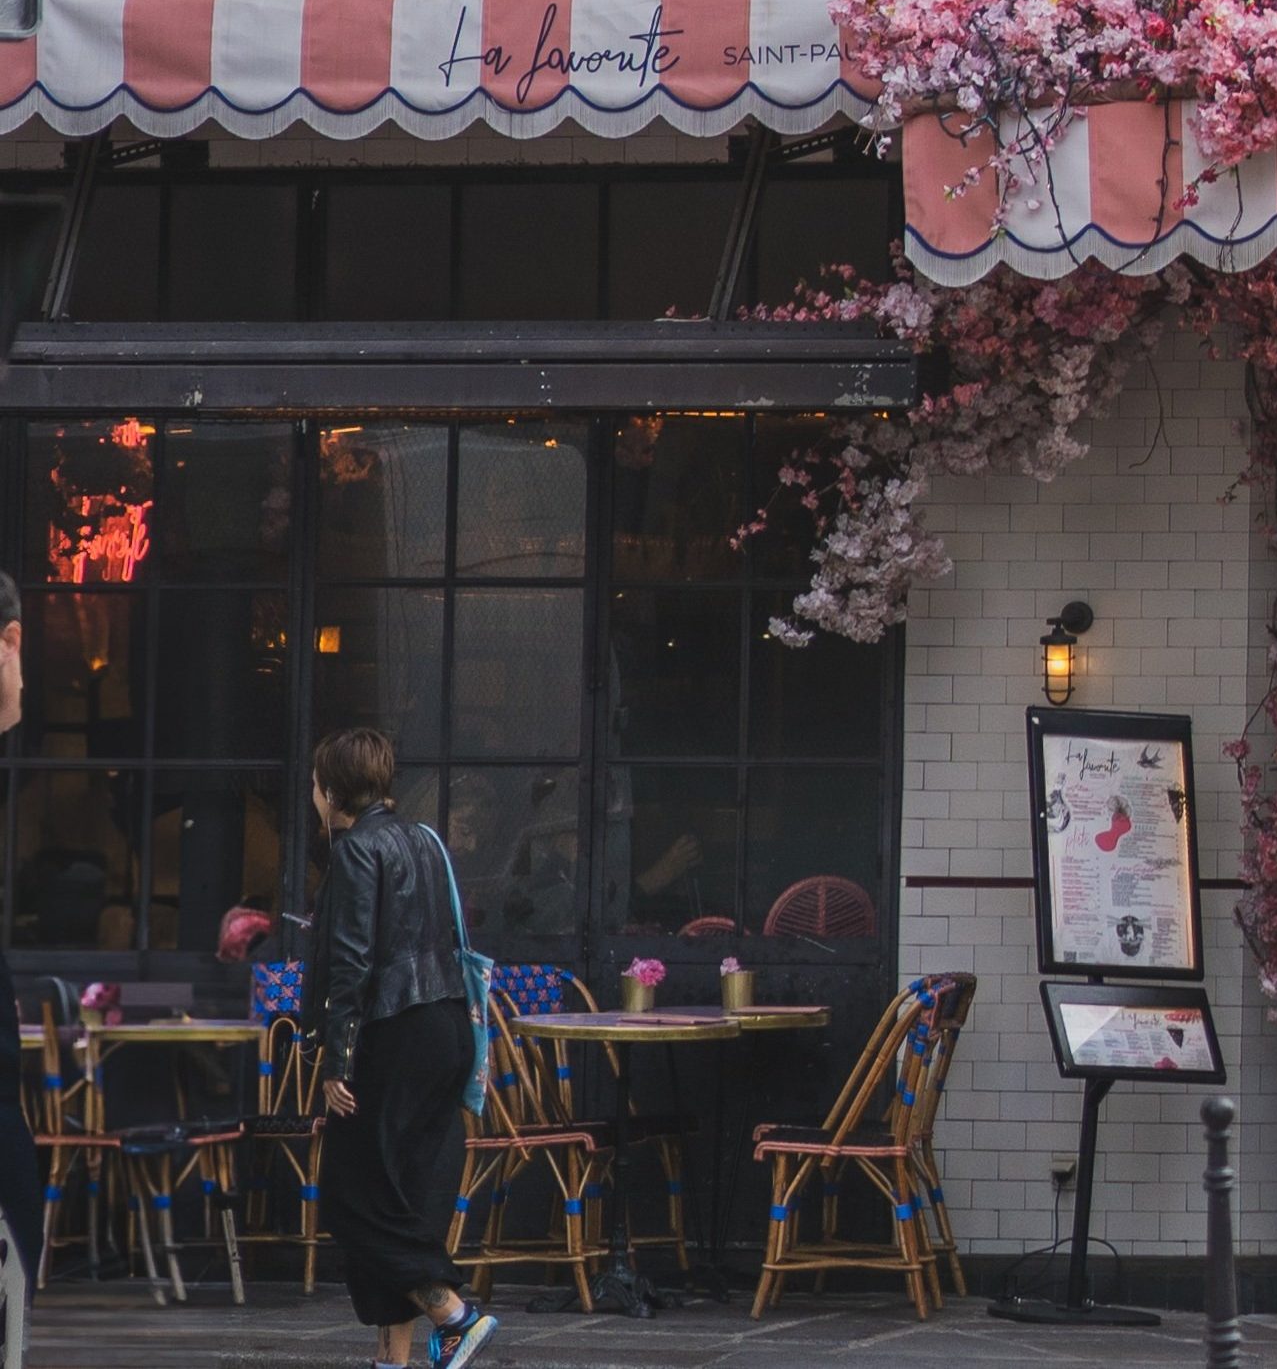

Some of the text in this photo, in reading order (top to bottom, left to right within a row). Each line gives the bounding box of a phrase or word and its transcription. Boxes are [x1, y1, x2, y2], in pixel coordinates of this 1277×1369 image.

[438, 3, 861, 105] La favorite SAINT-PAU
[1079, 748, 1121, 781] favorite
